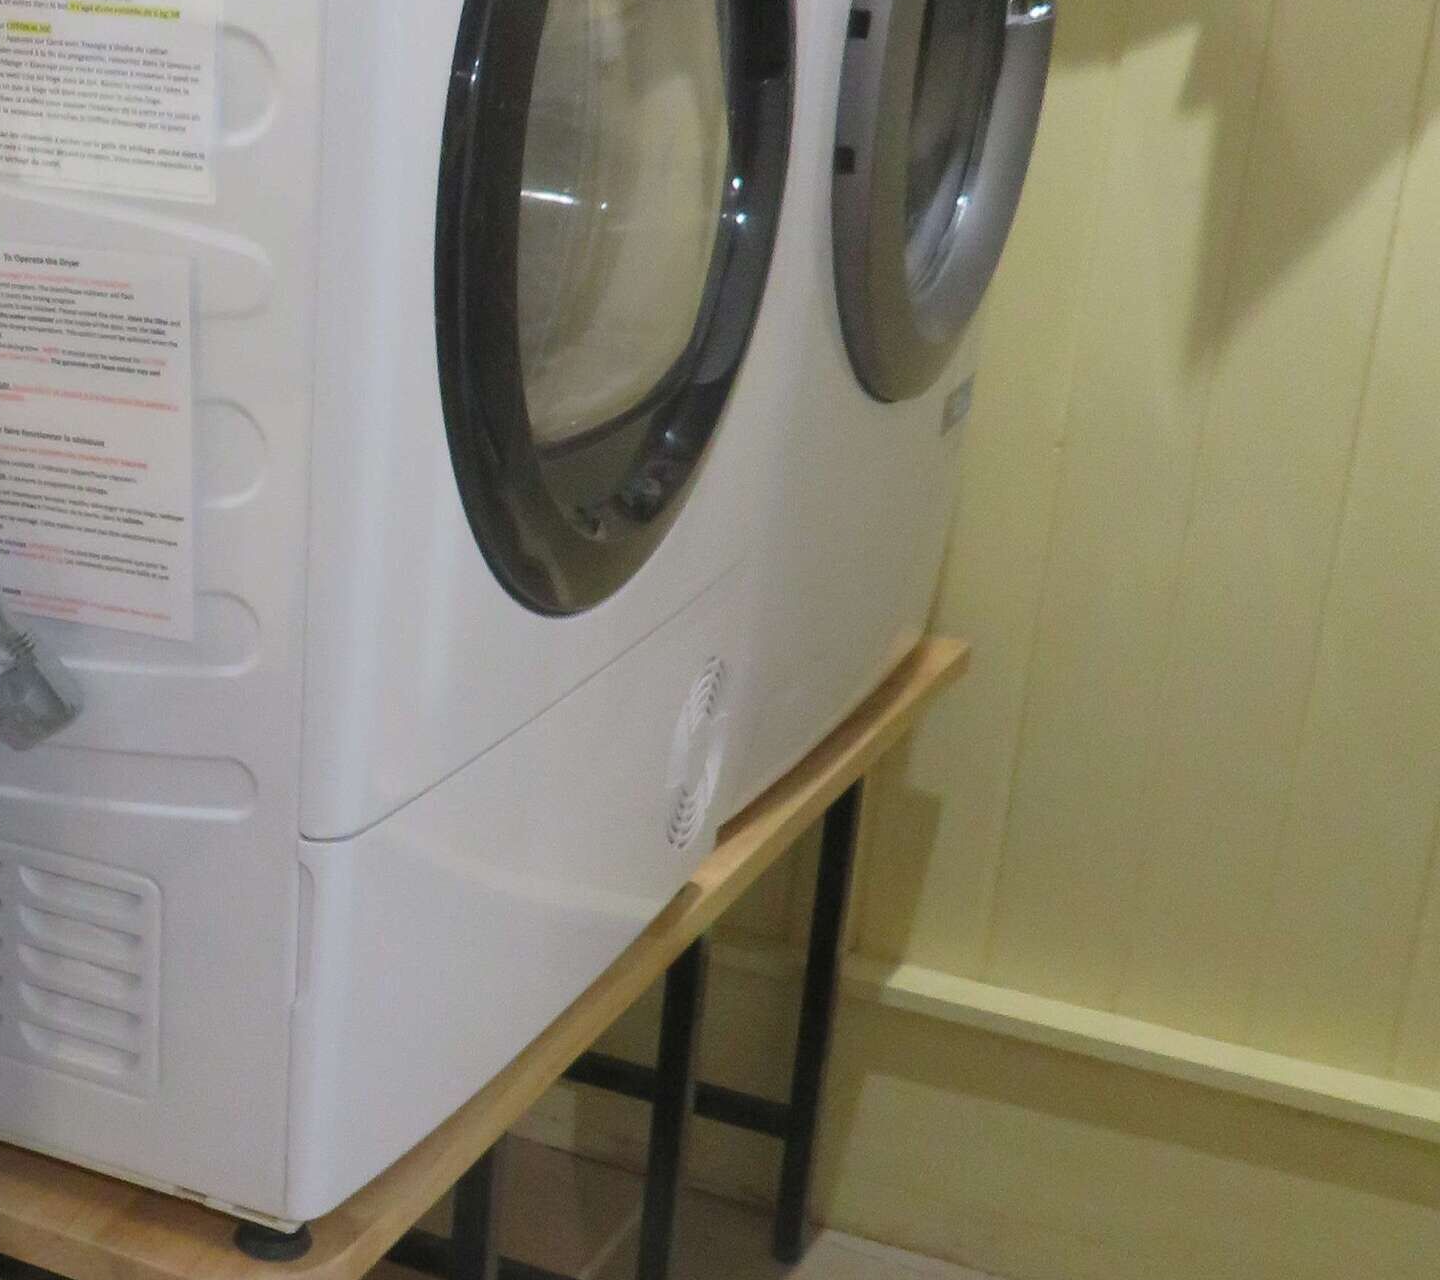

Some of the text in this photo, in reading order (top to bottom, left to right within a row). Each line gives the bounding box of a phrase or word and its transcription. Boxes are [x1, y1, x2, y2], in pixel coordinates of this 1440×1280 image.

[14, 254, 44, 265] Operate
[45, 257, 58, 266] the
[60, 257, 79, 268] Dryer
